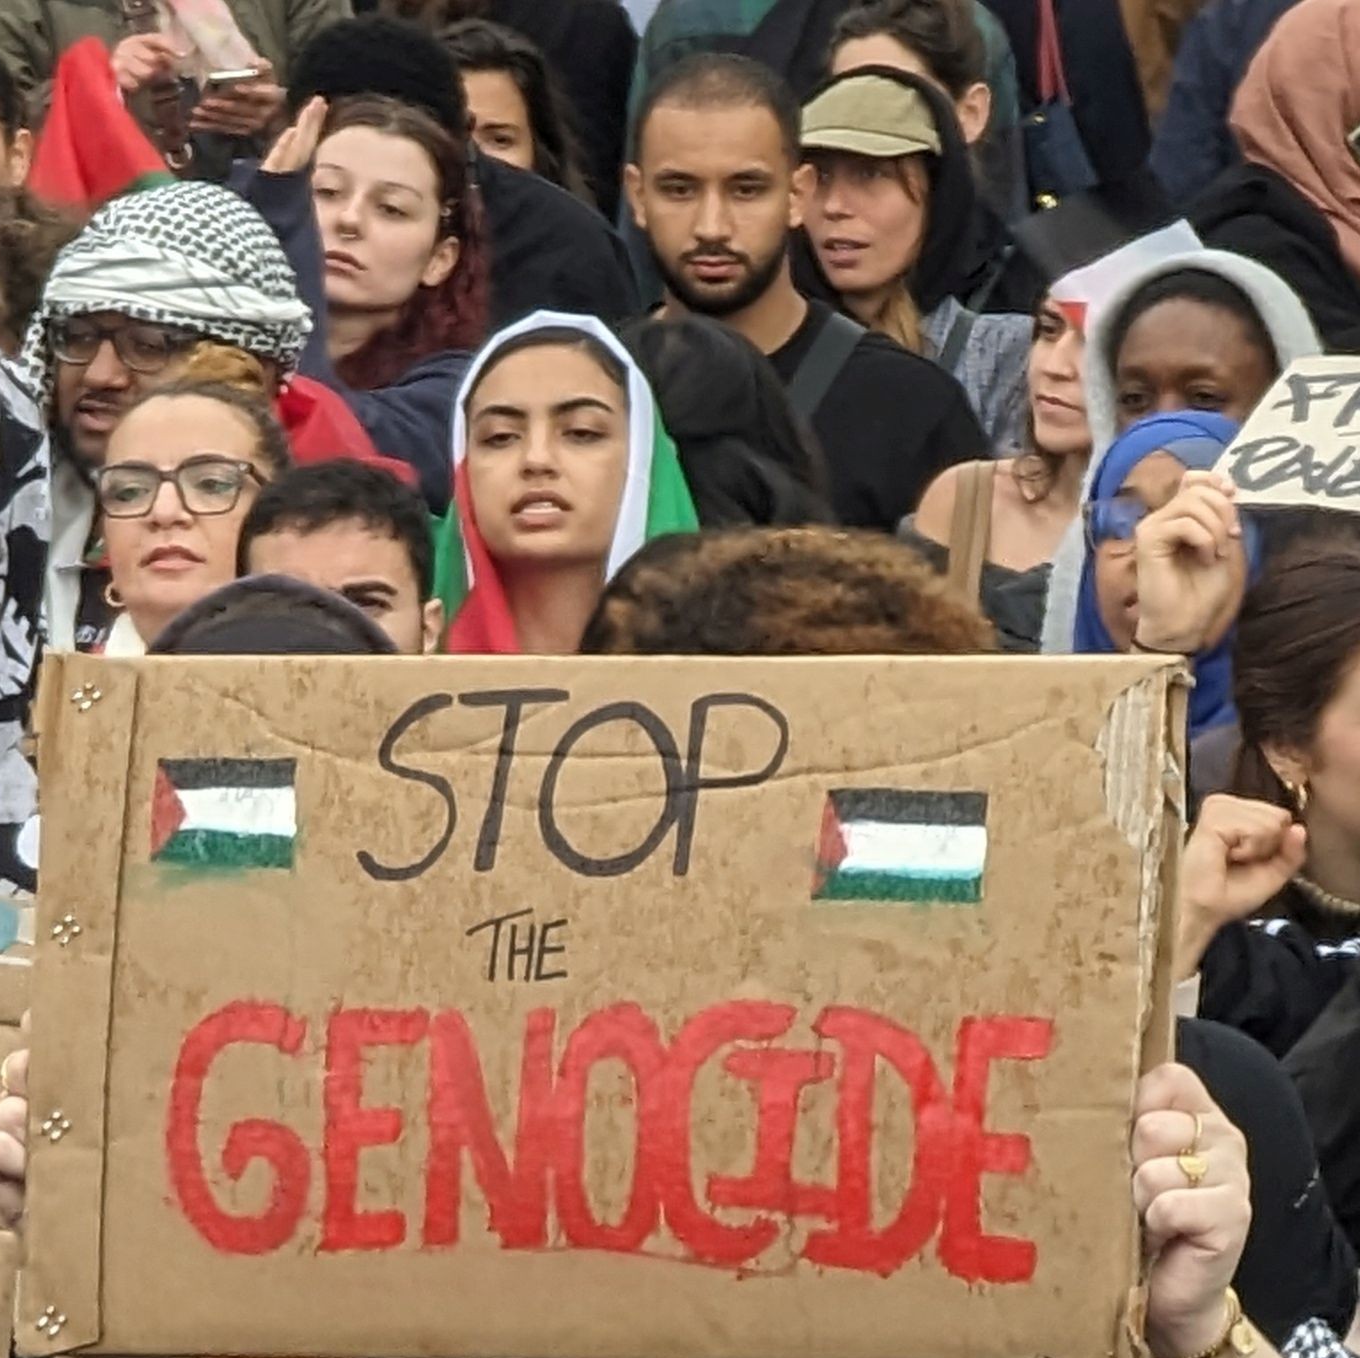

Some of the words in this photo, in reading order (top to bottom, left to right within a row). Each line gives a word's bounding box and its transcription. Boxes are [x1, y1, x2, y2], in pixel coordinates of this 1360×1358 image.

[356, 687, 789, 882] STOP
[466, 908, 570, 983] THE
[165, 999, 1056, 1284] GENOCIDE
